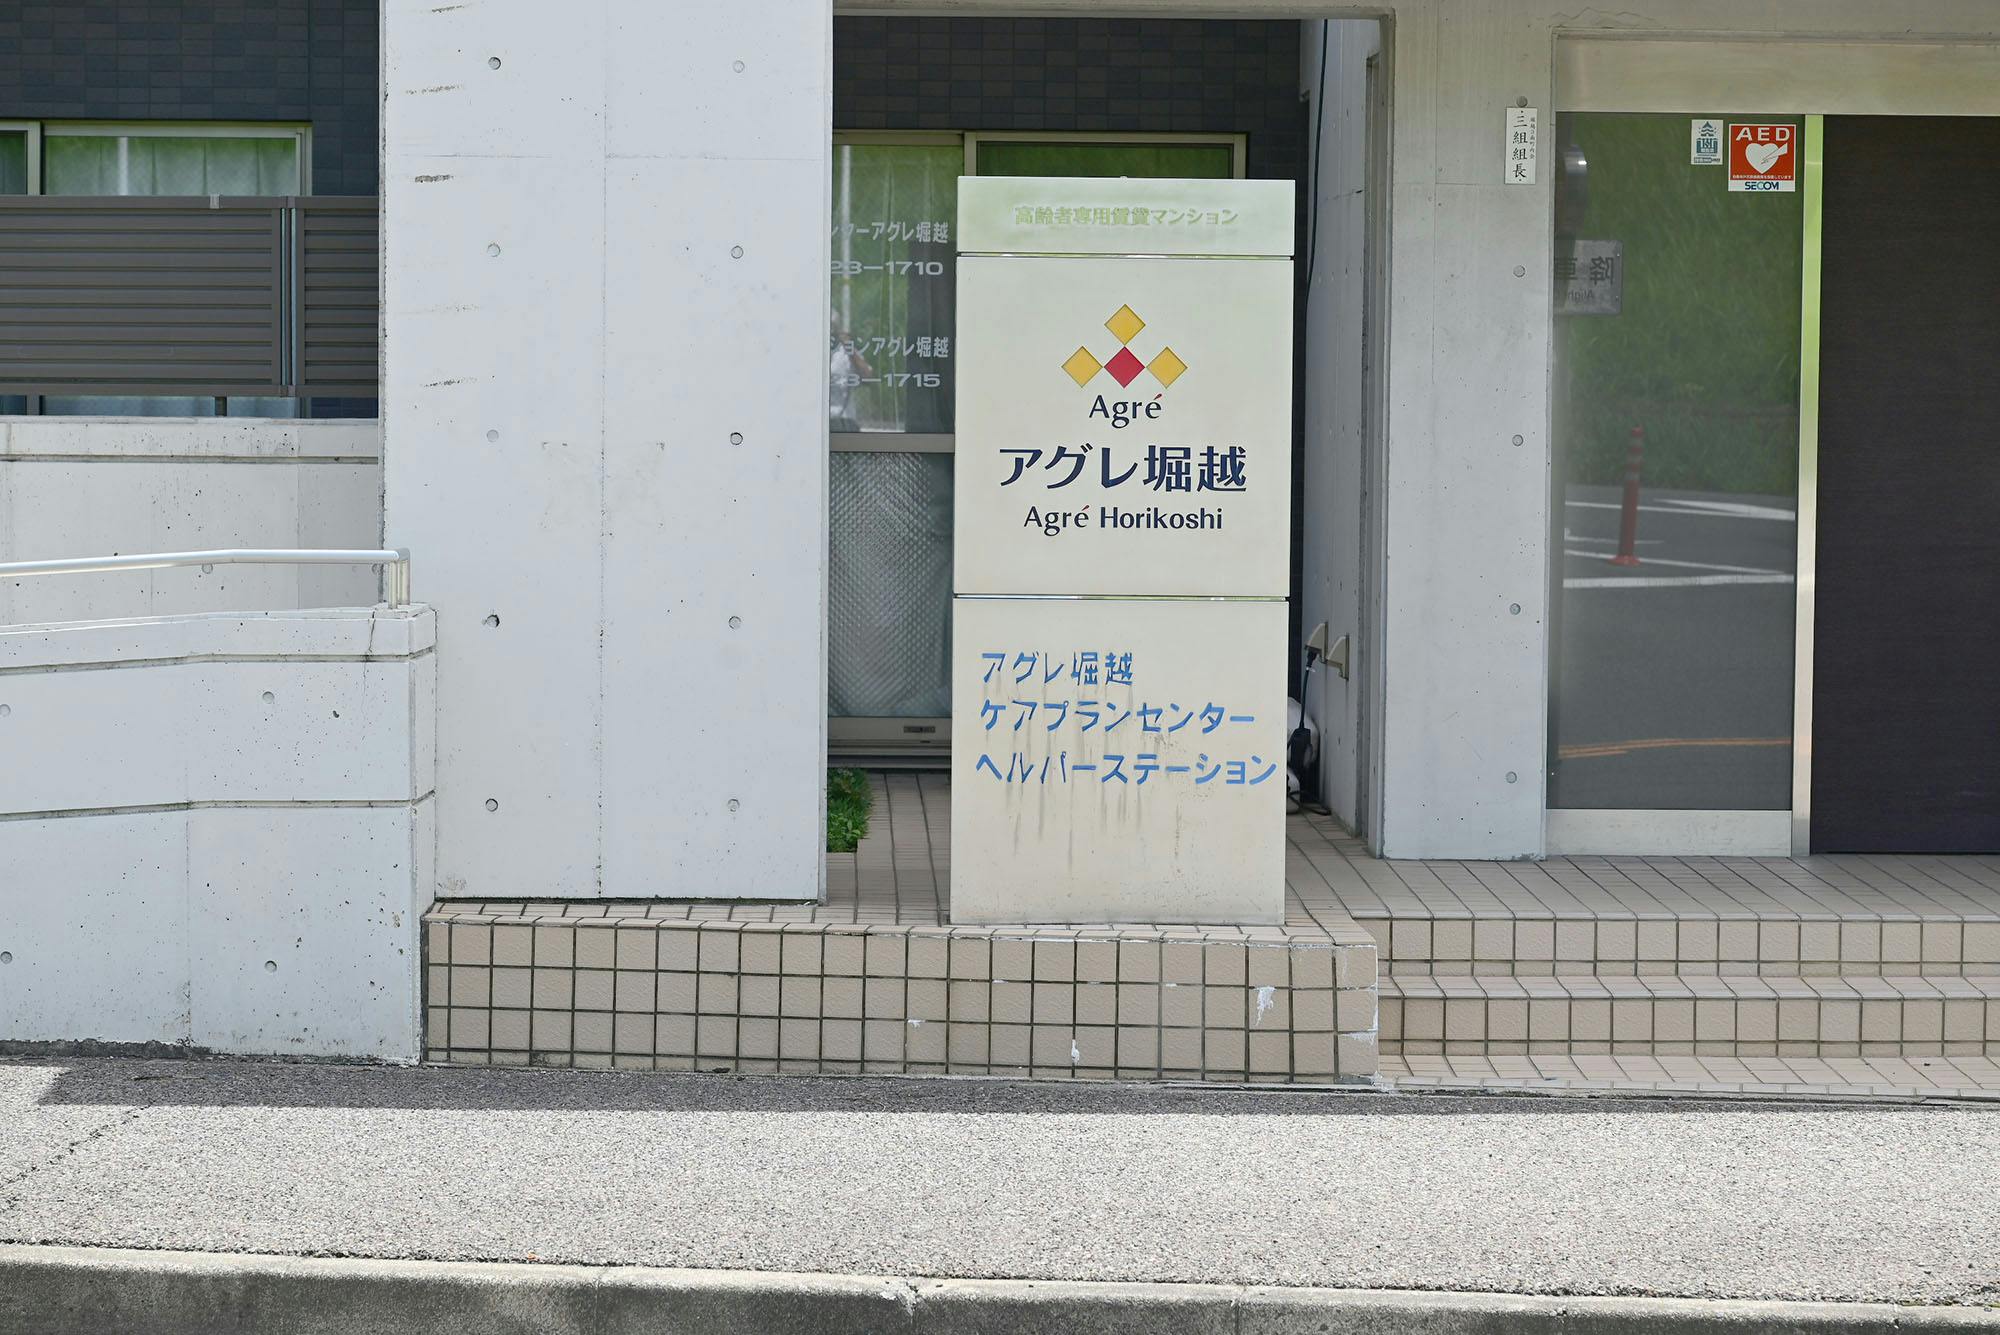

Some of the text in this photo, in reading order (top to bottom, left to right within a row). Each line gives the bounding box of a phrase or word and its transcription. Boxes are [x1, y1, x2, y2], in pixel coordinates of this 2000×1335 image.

[1512, 115, 1528, 178] 三組組長
[1736, 127, 1790, 141] AED
[1744, 181, 1780, 191] SECOM
[1014, 205, 1239, 226] 高齢者専用賃貸マンション
[1088, 393, 1163, 429] Agré
[999, 442, 1247, 493] アグレ堀越
[1023, 505, 1223, 537] Agré Horikoshi
[981, 651, 1134, 686] アグレ堀越
[980, 699, 1256, 735] ケアプランセンター
[975, 751, 1278, 785] ヘルパーステーション
